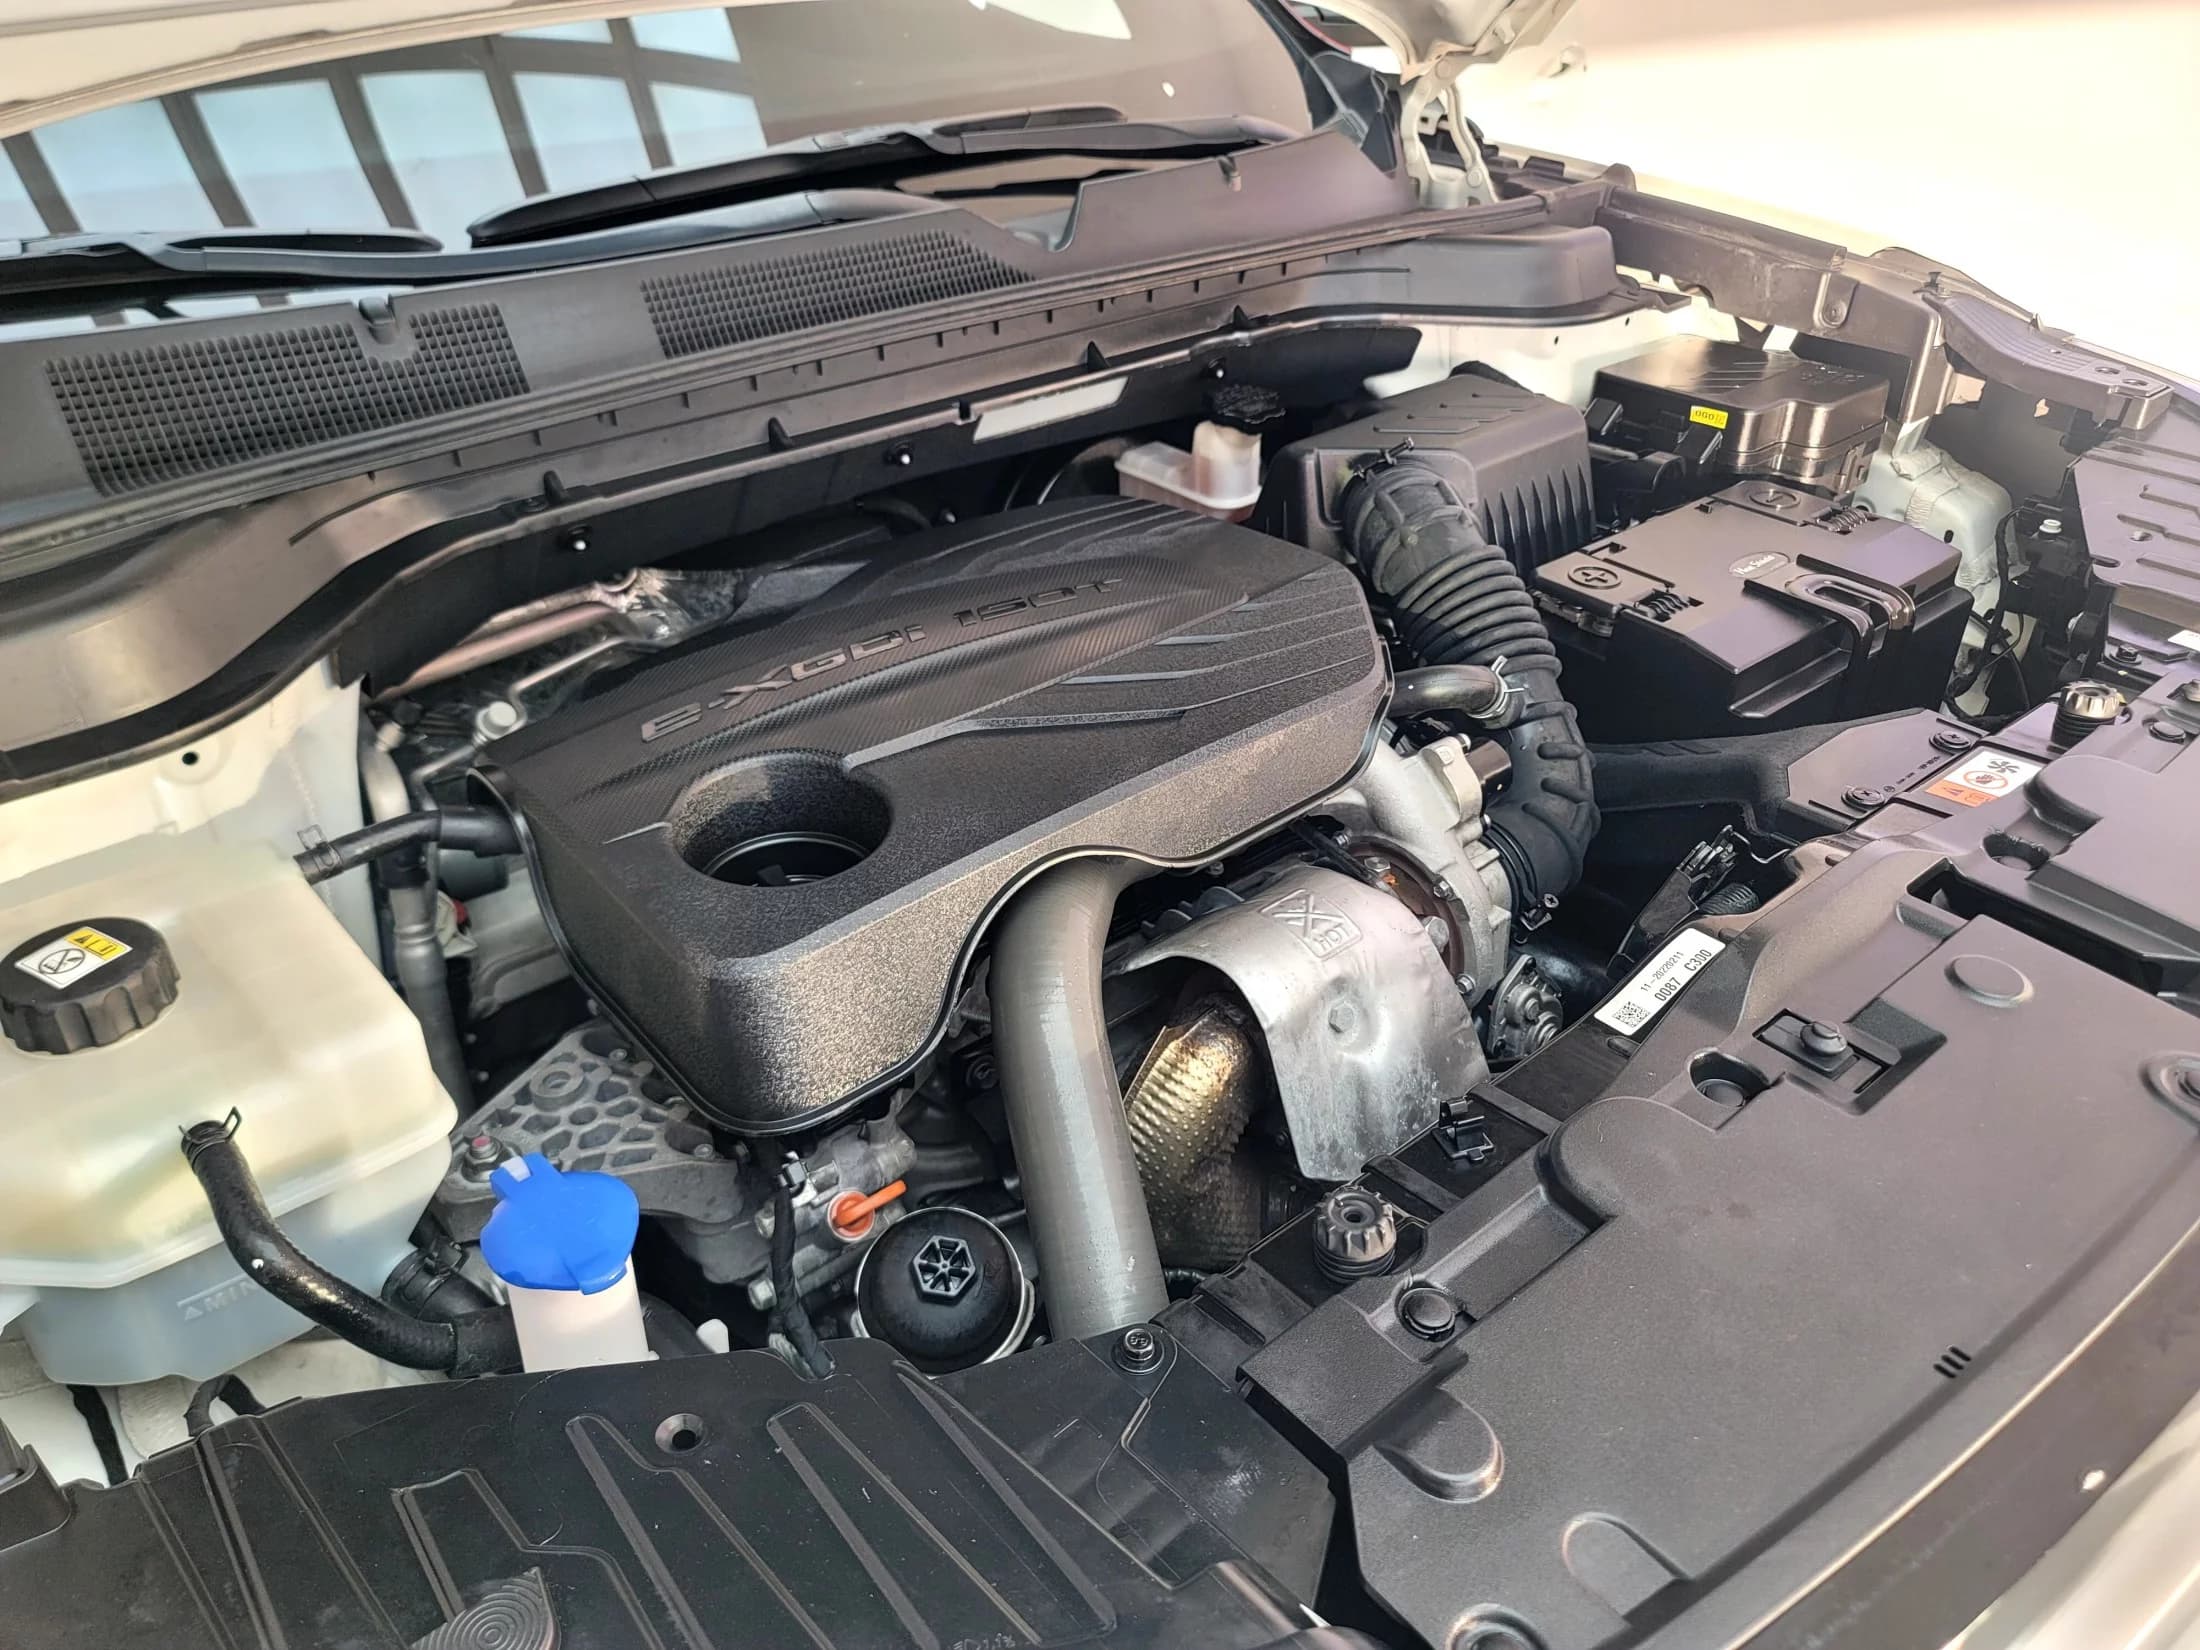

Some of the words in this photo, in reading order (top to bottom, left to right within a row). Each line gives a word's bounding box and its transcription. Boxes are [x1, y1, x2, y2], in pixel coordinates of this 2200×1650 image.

[1312, 921, 1350, 952] HOT
[1654, 977, 1681, 1002] 0087
[1684, 949, 1712, 972] C300
